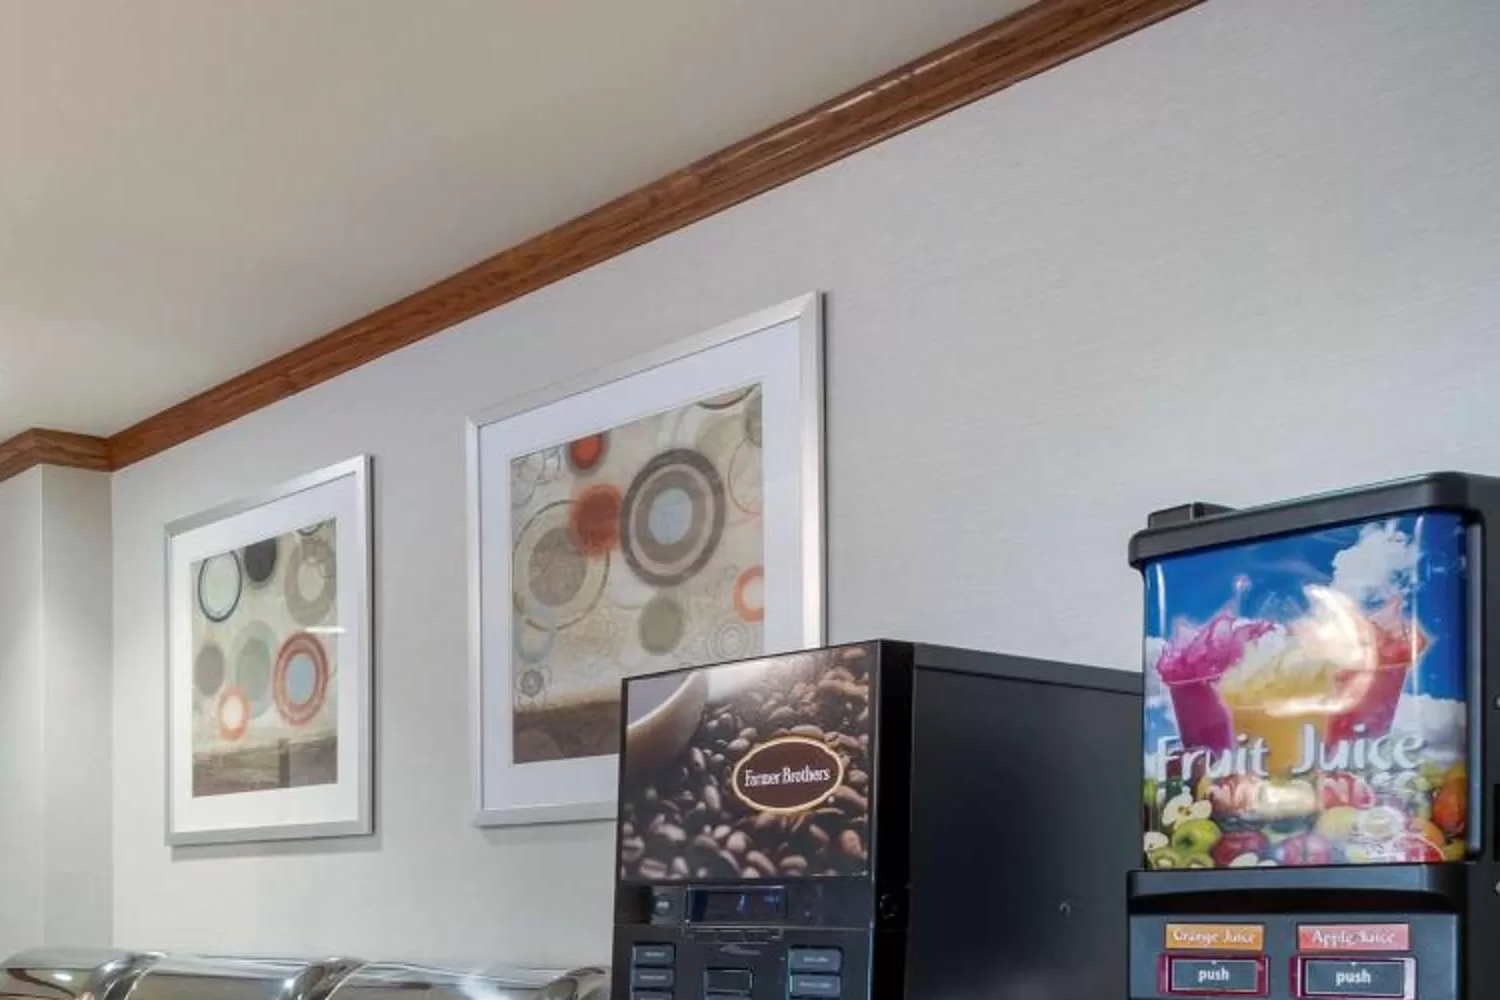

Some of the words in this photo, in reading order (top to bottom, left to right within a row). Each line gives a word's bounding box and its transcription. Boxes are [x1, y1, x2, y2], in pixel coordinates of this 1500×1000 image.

[1157, 733, 1269, 782] Fruit
[1292, 723, 1425, 773] Juice
[782, 764, 831, 785] Brothers
[1172, 927, 1218, 944] Orange
[1223, 927, 1255, 944] Juice
[1312, 928, 1353, 948] Apple
[1354, 930, 1396, 944] Juice
[1197, 968, 1231, 983] push
[1335, 969, 1372, 987] push
